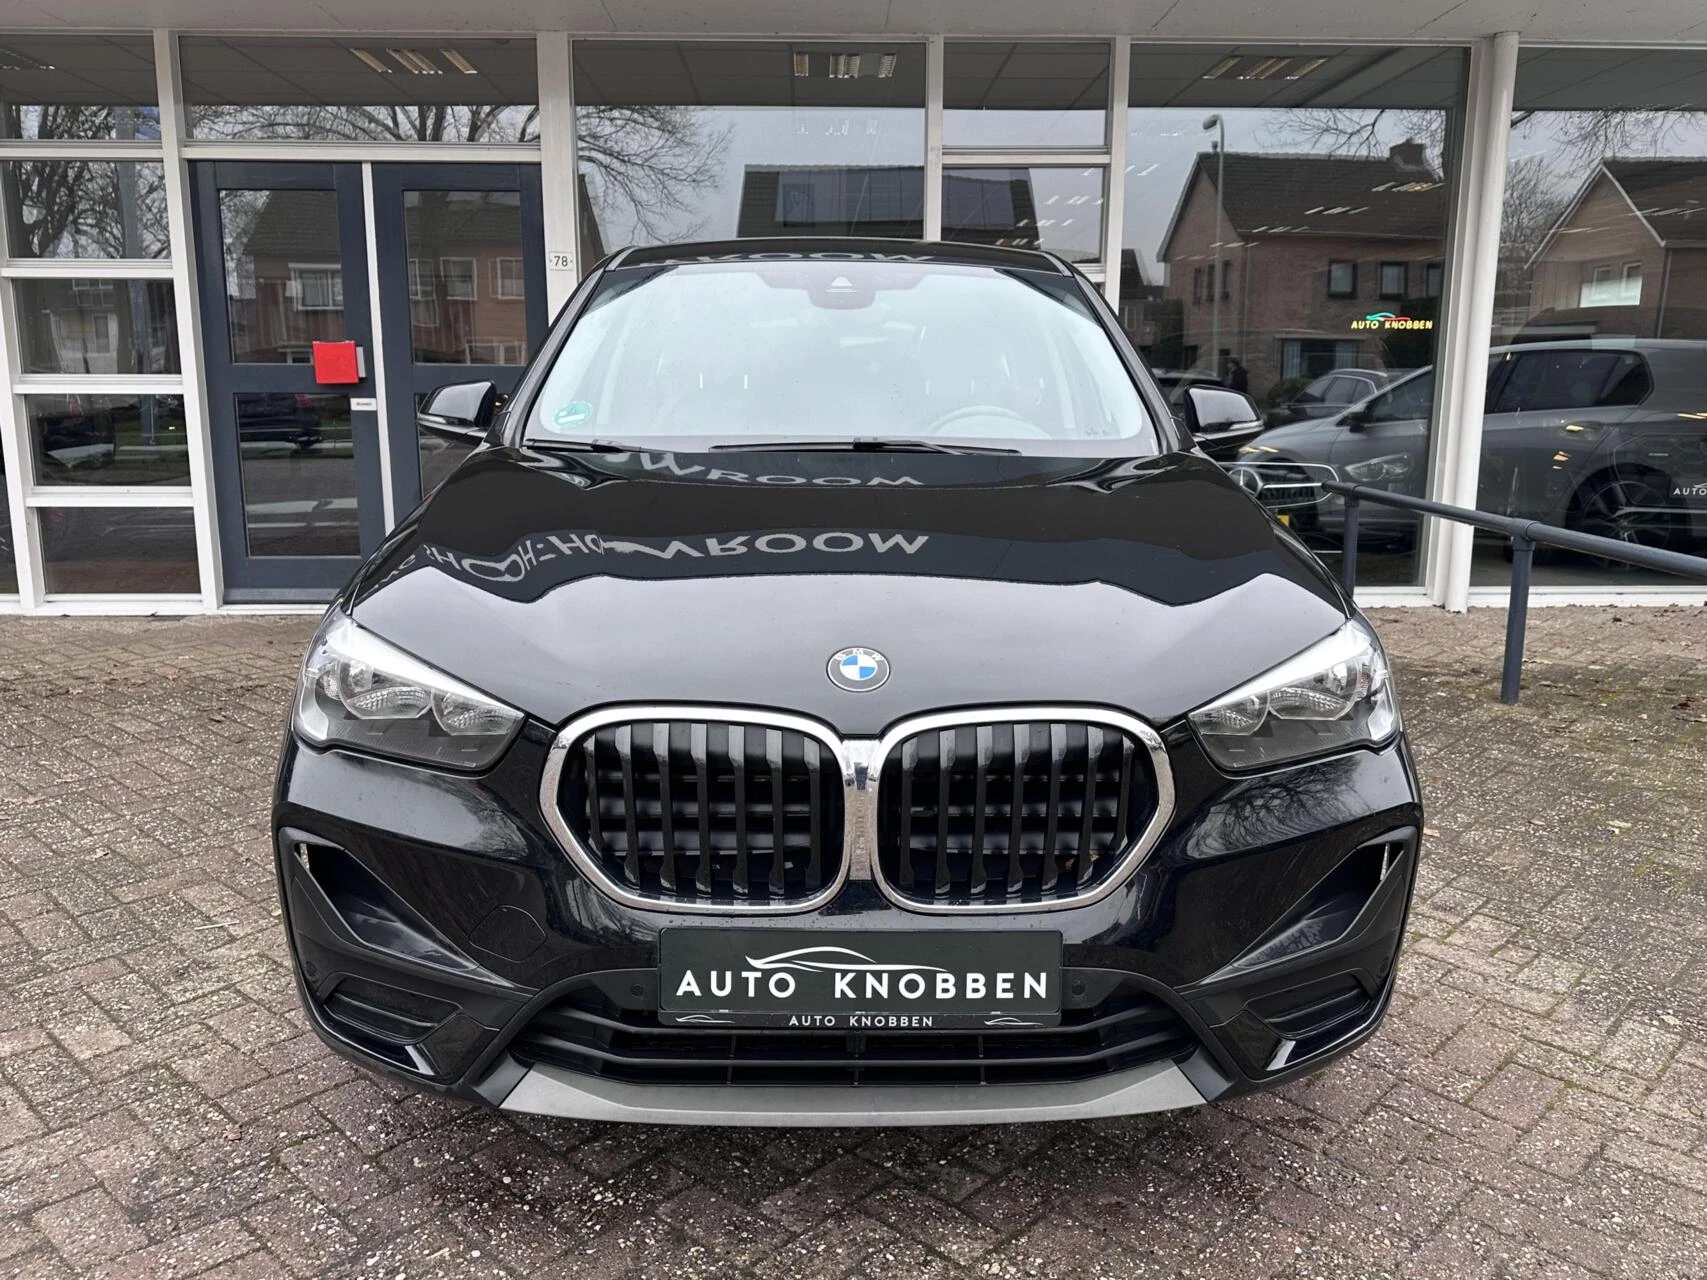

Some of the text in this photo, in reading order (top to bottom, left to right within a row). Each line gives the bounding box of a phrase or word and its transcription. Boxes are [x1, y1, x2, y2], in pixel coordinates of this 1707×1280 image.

[554, 255, 568, 267] 78
[1350, 320, 1433, 330] AUTO KNOBBEN
[1673, 487, 1707, 496] AUTO
[676, 970, 1047, 999] AUTO KNOBBEN
[788, 1015, 933, 1027] AUTO KNOBBEN
